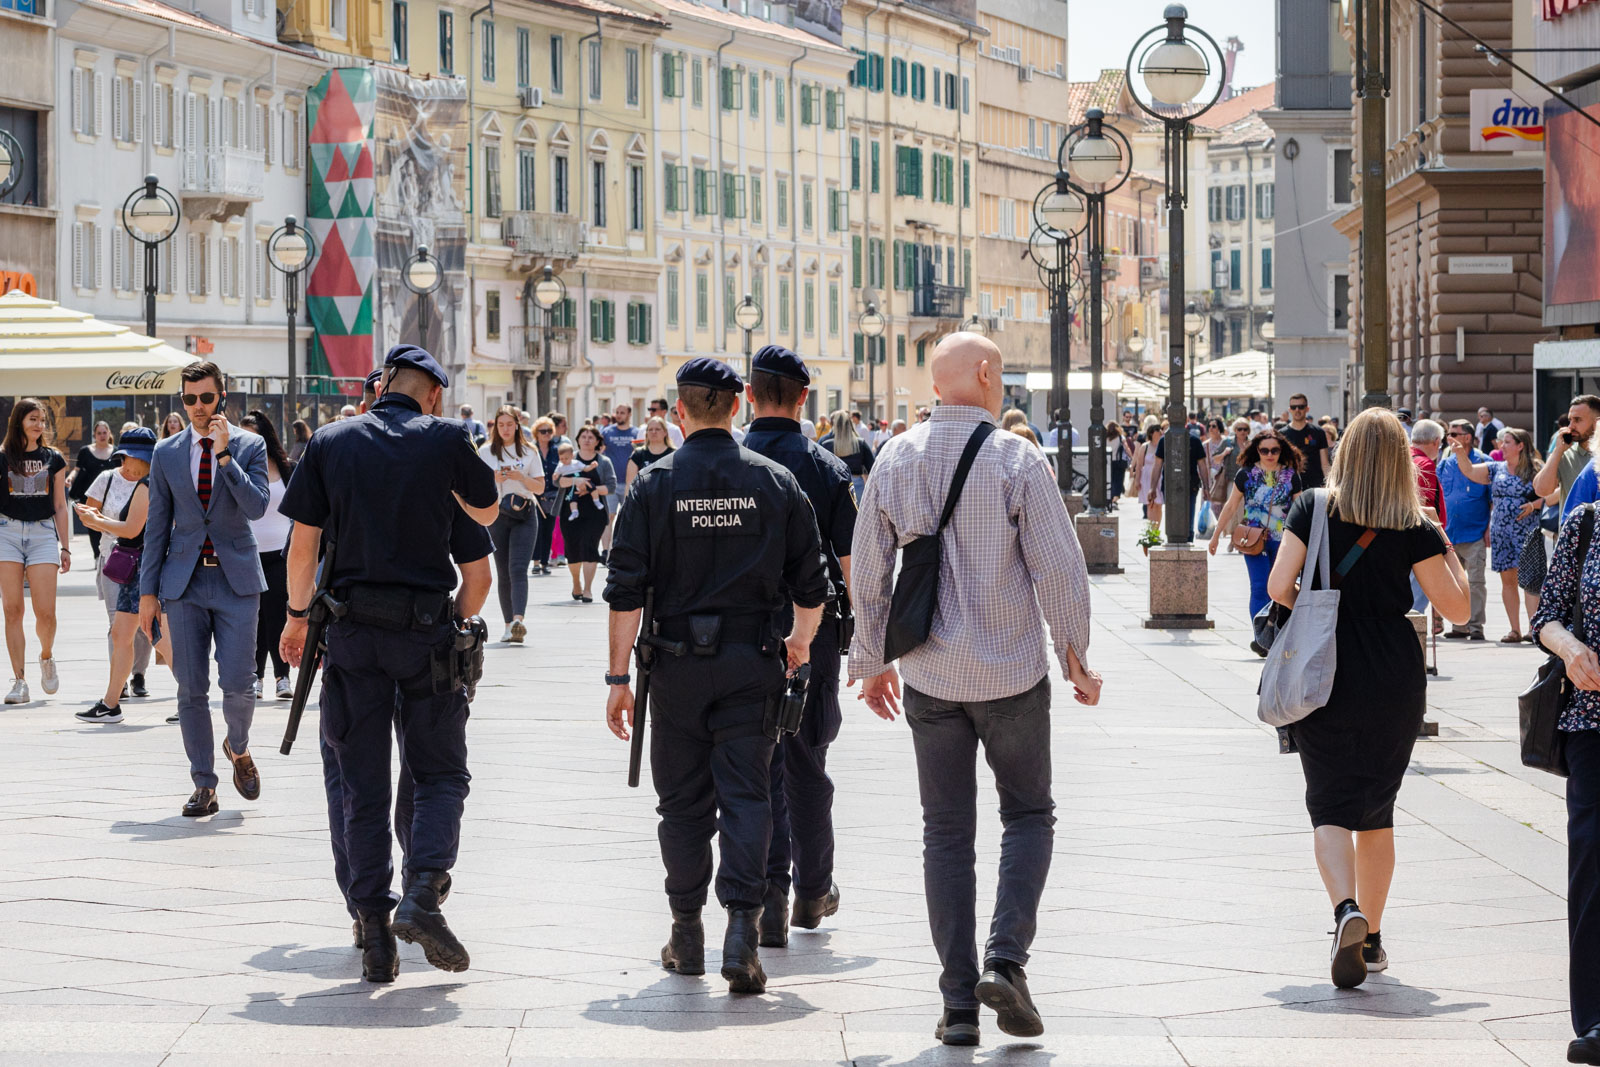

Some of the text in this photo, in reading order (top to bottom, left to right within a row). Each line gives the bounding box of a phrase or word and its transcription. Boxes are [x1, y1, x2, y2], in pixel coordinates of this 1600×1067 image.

[1492, 98, 1540, 126] dm
[676, 497, 757, 512] INTERVENTNA
[691, 514, 742, 528] POLICIJA
